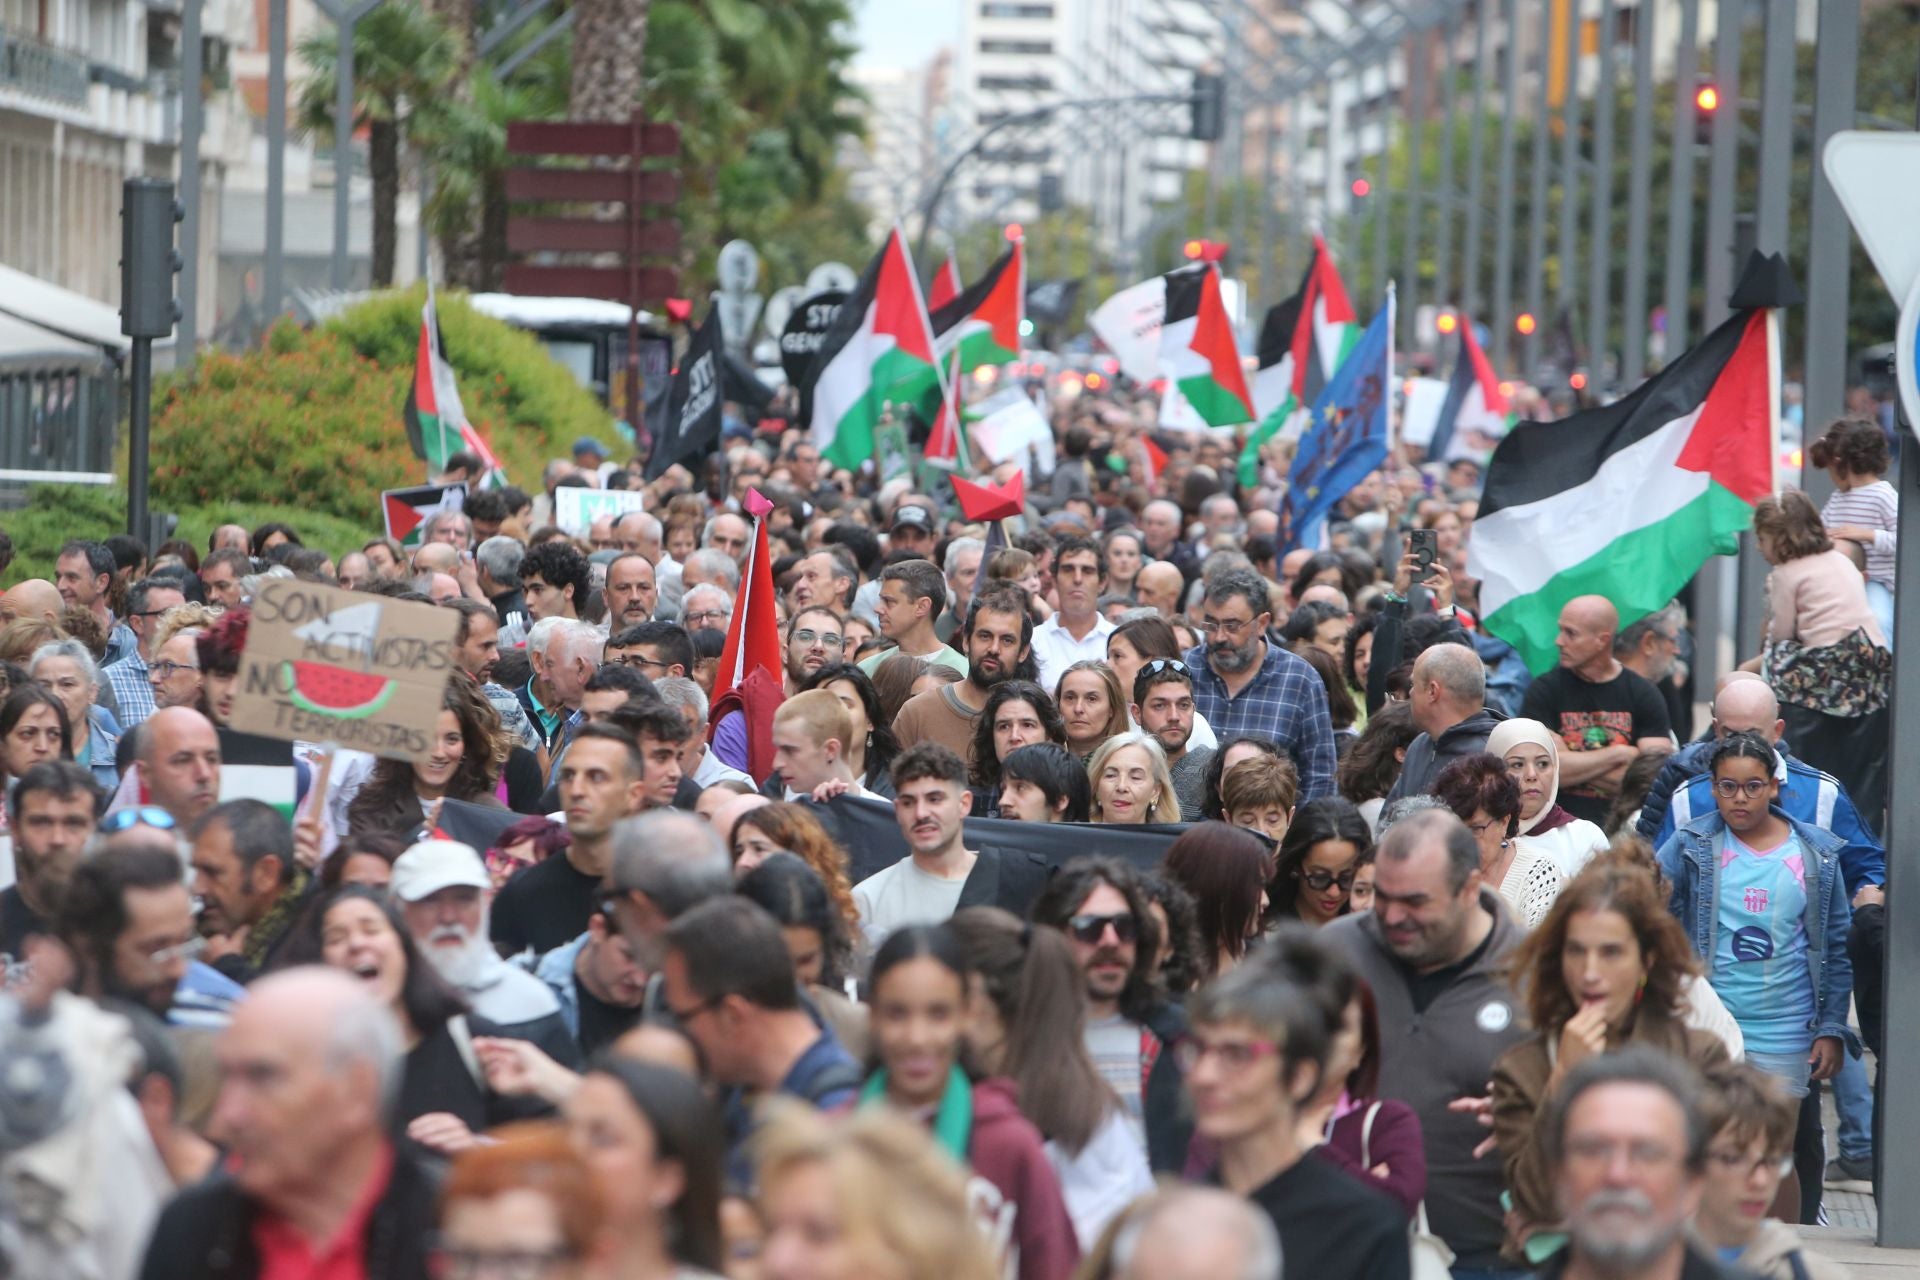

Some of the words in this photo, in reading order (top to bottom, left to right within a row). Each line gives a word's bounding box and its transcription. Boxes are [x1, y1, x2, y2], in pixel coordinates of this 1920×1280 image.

[256, 582, 334, 625] SON
[301, 630, 452, 672] ACTIVISTAS
[244, 660, 295, 696] NO
[273, 699, 427, 752] TERRORISTAS
